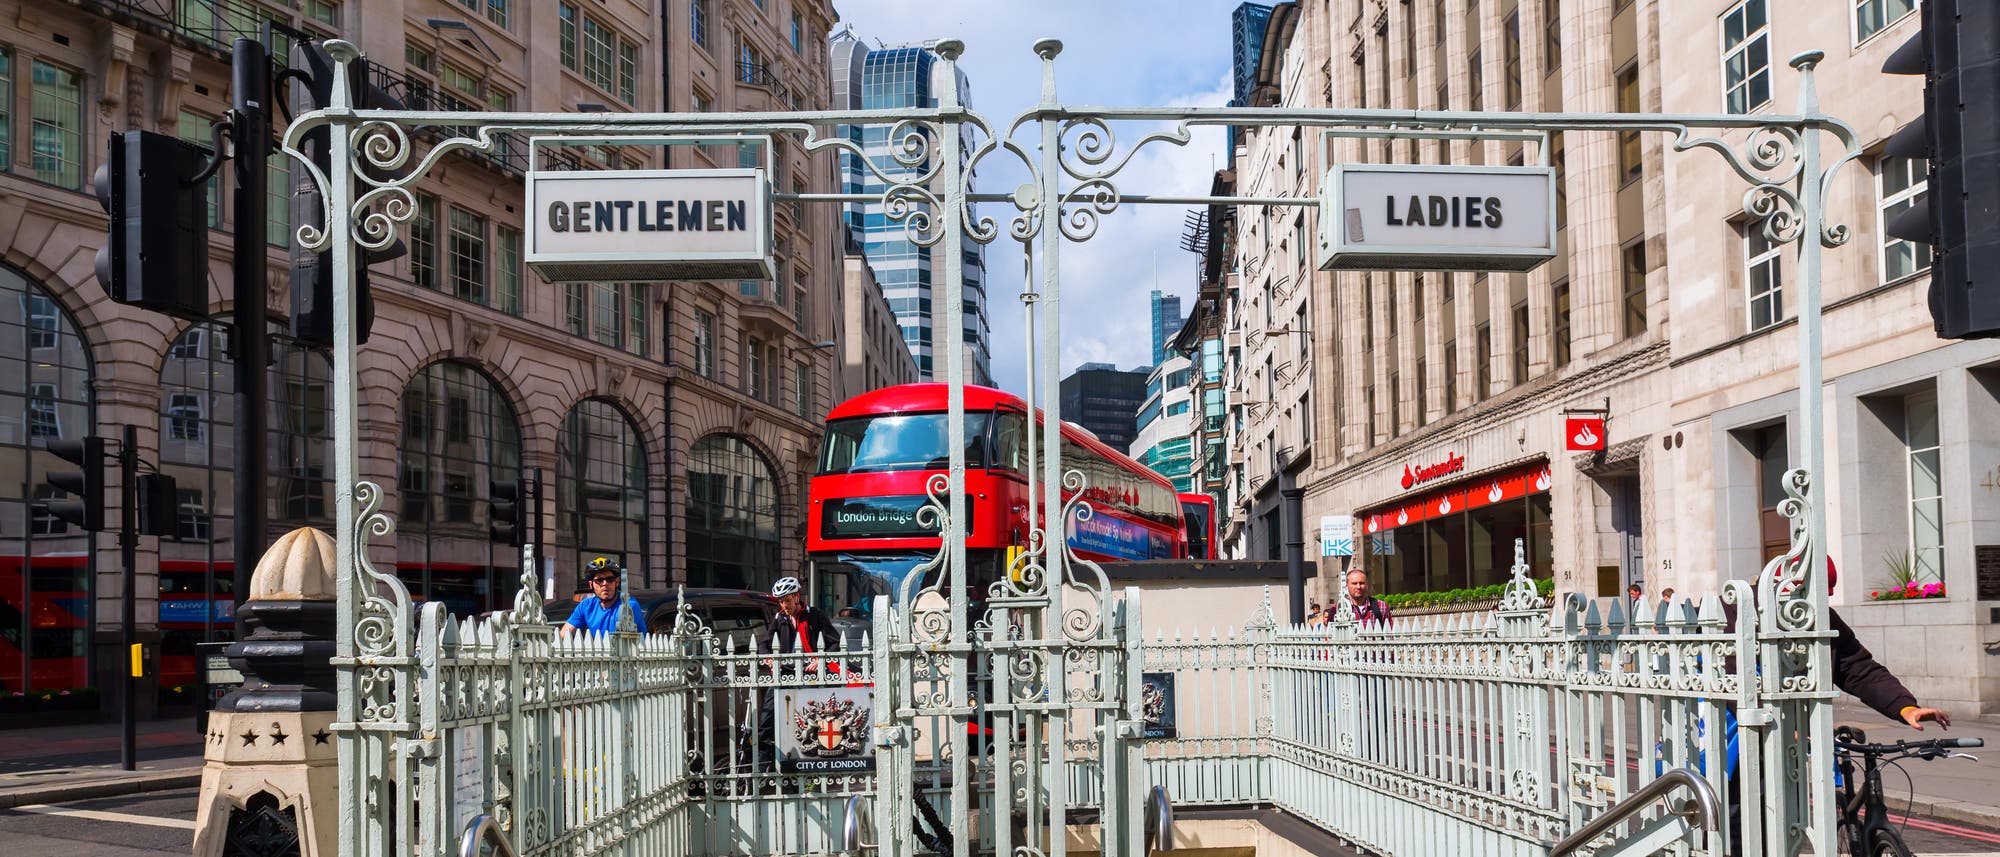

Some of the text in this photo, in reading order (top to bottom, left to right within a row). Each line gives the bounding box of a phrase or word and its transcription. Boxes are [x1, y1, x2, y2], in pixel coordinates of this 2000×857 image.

[548, 200, 746, 232] GENTLEMEN
[1386, 195, 1503, 229] LADIES
[1414, 451, 1465, 484] Santander
[837, 508, 913, 525] London Bridge
[1662, 559, 1672, 570] 51
[1564, 570, 1571, 580] 51
[796, 760, 867, 769] CITY OF LONDON
